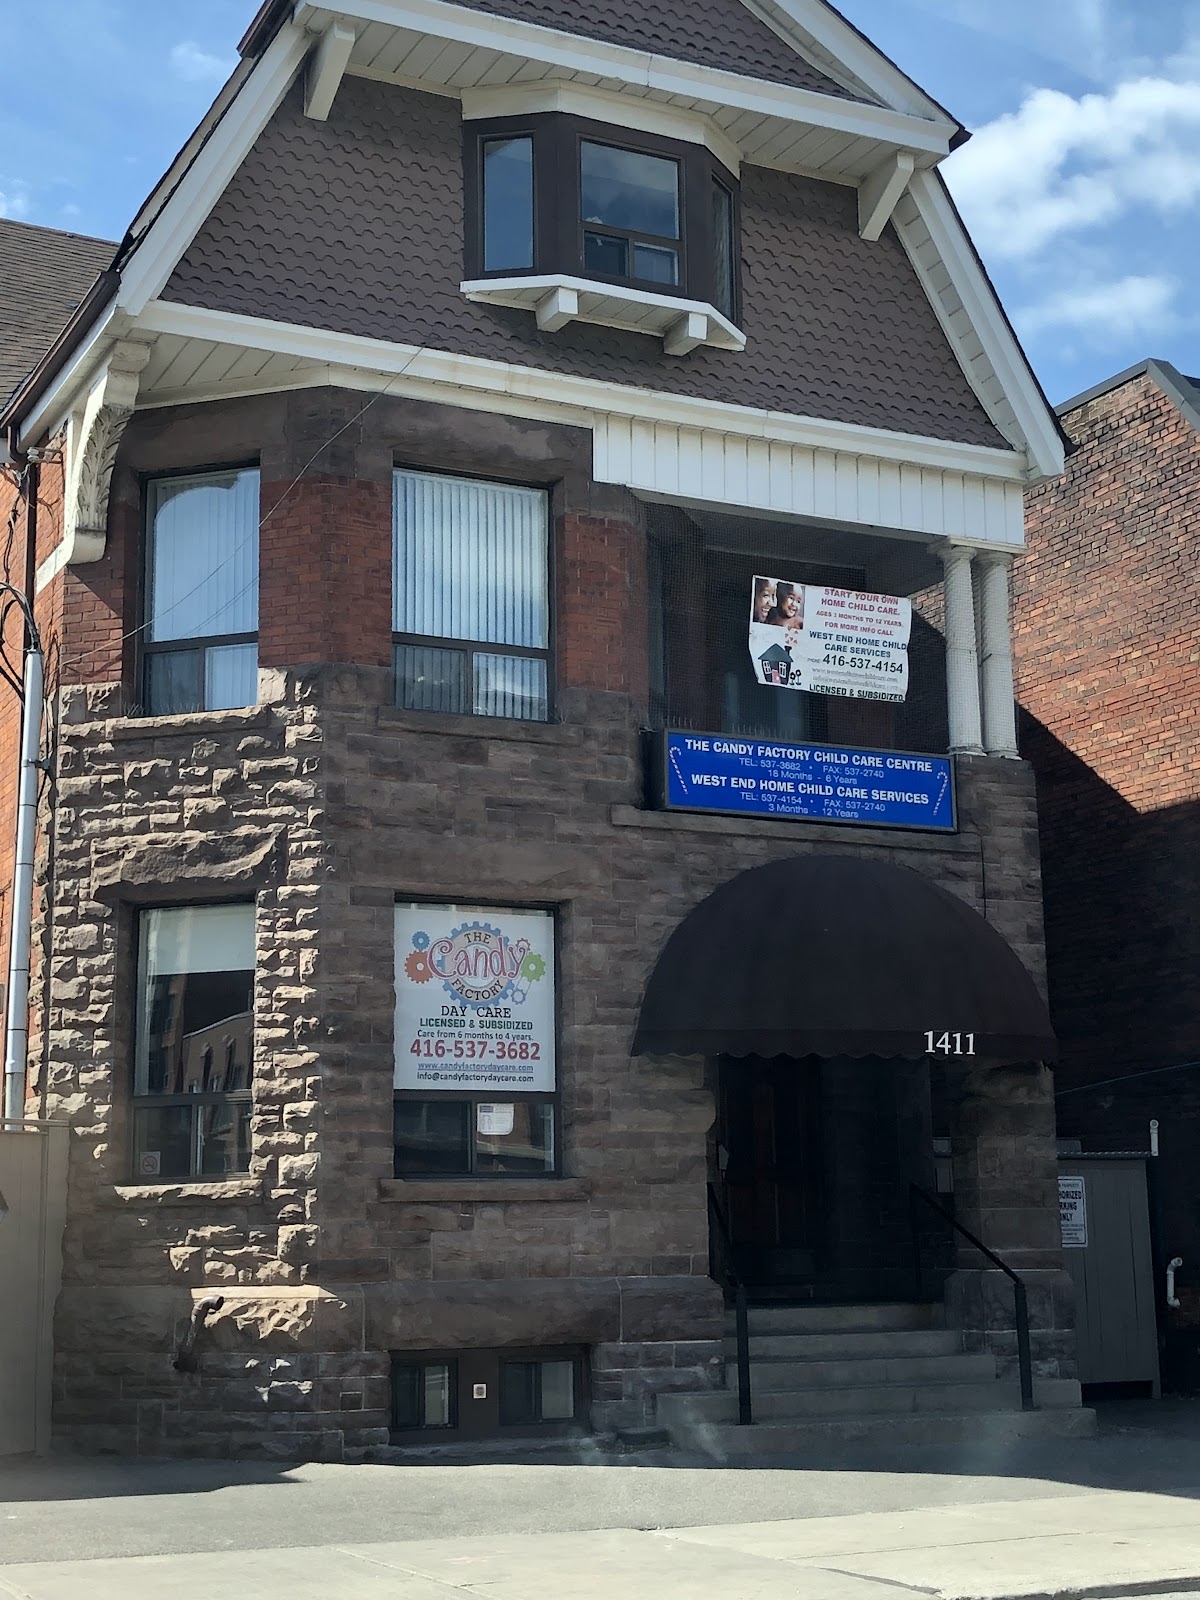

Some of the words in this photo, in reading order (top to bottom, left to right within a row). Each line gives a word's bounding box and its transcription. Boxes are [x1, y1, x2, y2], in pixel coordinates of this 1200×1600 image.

[824, 589, 852, 598] START
[855, 593, 879, 602] YOUR
[881, 596, 898, 605] OWN
[821, 598, 845, 608] HOME
[848, 602, 875, 612] CHILD
[877, 606, 900, 615] CARE.
[838, 613, 864, 622] MONTHS
[809, 630, 833, 640] WEST
[836, 634, 853, 643] END
[855, 637, 880, 647] HOME
[882, 640, 907, 651] CHILD
[825, 643, 847, 652] CARE
[850, 647, 891, 658] SERVICES
[822, 654, 903, 673] 416-537-4154
[809, 684, 846, 695] LICENSED
[857, 690, 904, 702] SUBSIDIZED
[685, 739, 710, 751] THE
[713, 742, 753, 755] CANDY
[758, 746, 810, 761] FACTORY
[814, 751, 848, 764] CHILD
[852, 755, 883, 767] CARE
[886, 758, 932, 772] CENTRE
[739, 758, 758, 766] TEL:
[760, 760, 801, 770] 537-3682
[823, 765, 842, 773] FAX:
[845, 767, 884, 778] 537-2740
[768, 769, 778, 777] 18
[781, 771, 813, 780] Months
[833, 776, 857, 784] Years
[691, 774, 727, 786] WEST
[731, 777, 756, 789] END
[760, 780, 795, 792] HOME
[798, 783, 833, 795] CHILD
[837, 787, 868, 799] CARE
[871, 790, 928, 804] SERVICES
[740, 792, 758, 800] TEL:
[761, 794, 802, 804] 537-4154
[824, 799, 843, 807] FAX:
[846, 801, 885, 811] 537-2740
[777, 805, 808, 814] Months
[822, 808, 832, 816] 12
[835, 810, 859, 818] Years
[464, 932, 491, 944] THE
[428, 937, 526, 978] Candy
[452, 979, 503, 1000] FACTORY
[441, 1006, 467, 1016] DAY
[476, 1007, 511, 1018] CARE
[420, 1018, 465, 1028] LICENSED
[469, 1020, 475, 1028] &
[479, 1020, 532, 1030] SUBSIDIZED
[418, 1030, 434, 1038] Care
[464, 1032, 493, 1040] months
[923, 1030, 975, 1055] 1411
[410, 1039, 540, 1060] 416-537-3682
[418, 1062, 533, 1072] www.candyfactorydaycare.com
[417, 1072, 534, 1082] info@candyfactorydaycare.com
[1059, 1191, 1082, 1199] HORIZED
[1059, 1202, 1077, 1210] RKING
